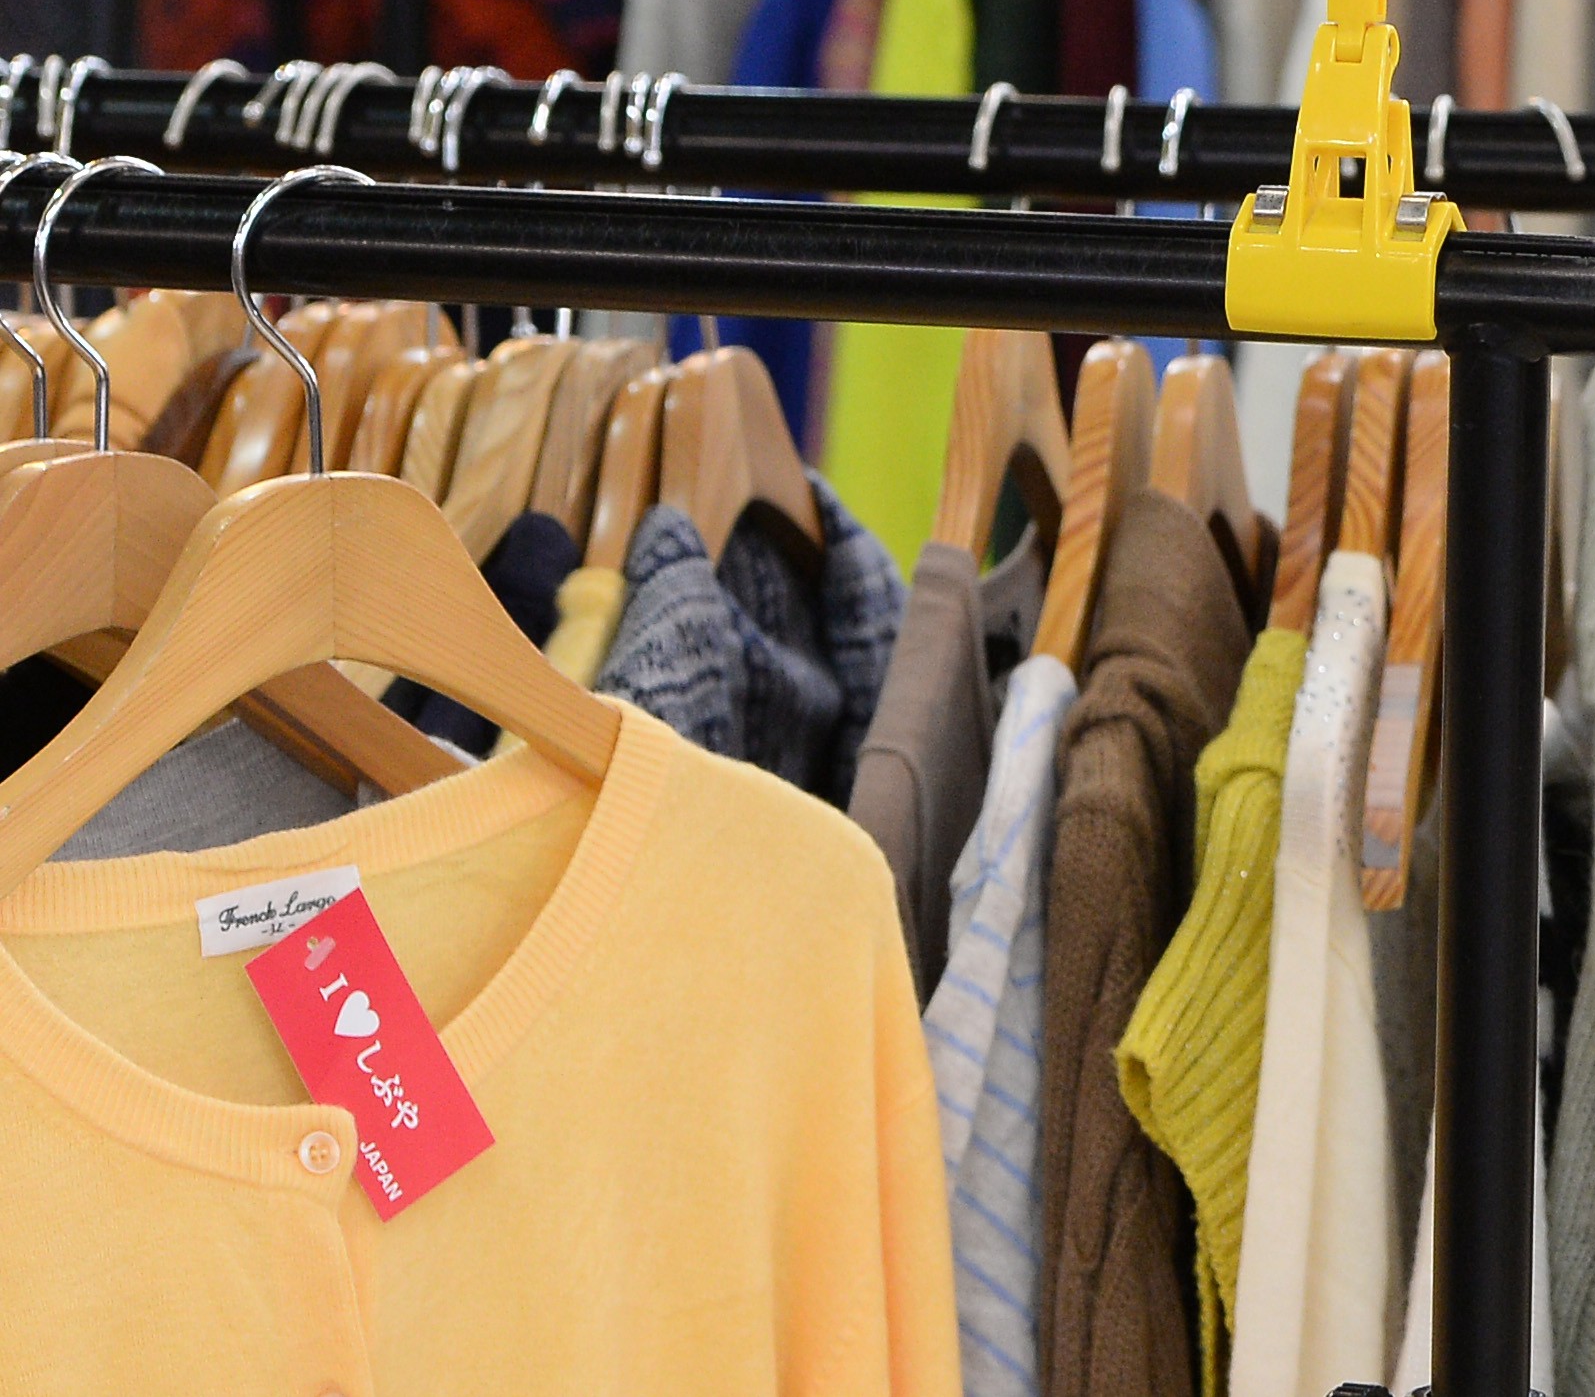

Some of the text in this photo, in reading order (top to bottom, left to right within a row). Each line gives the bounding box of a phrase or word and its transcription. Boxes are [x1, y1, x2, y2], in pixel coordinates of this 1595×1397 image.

[218, 901, 277, 933] French
[318, 972, 420, 1130] I しぶや
[358, 1140, 404, 1203] JAPAN
